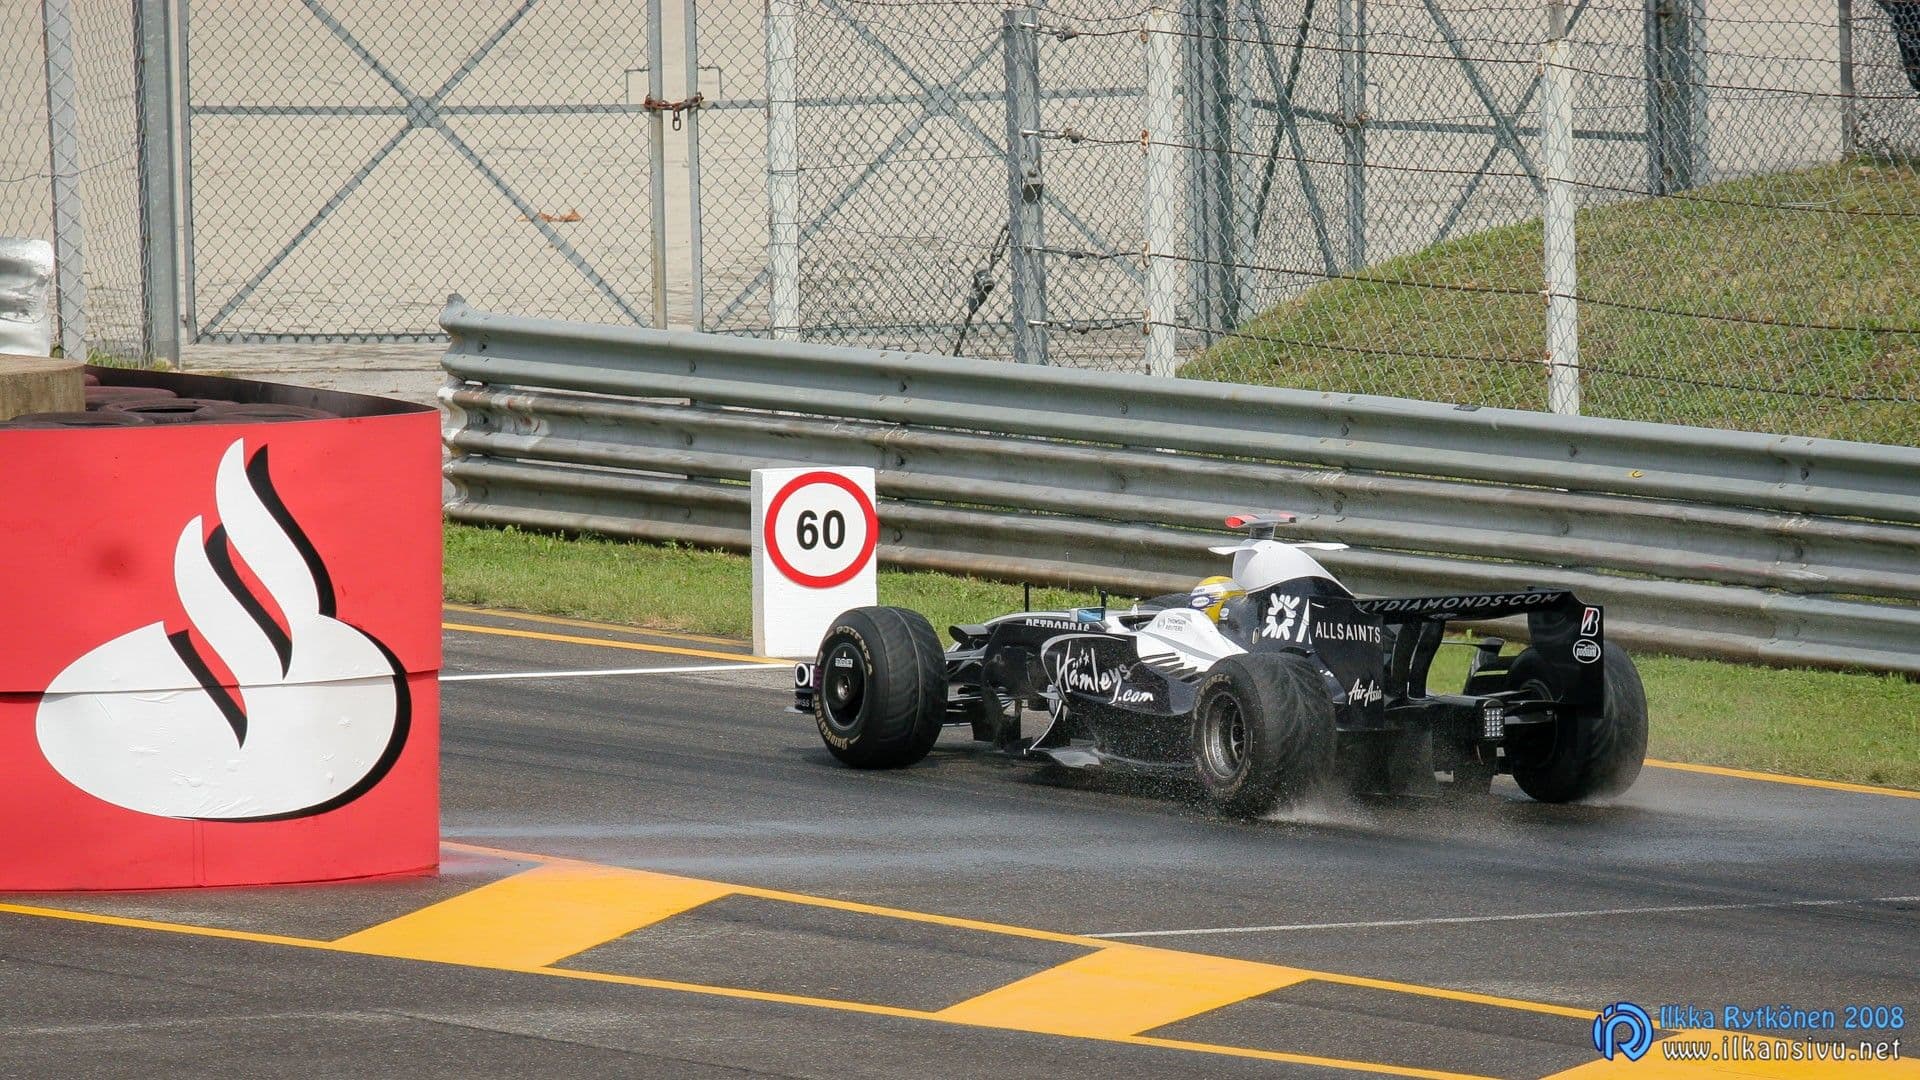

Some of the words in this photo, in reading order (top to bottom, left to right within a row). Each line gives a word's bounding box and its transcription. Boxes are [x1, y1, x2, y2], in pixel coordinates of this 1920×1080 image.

[797, 509, 845, 550] 60
[1315, 621, 1381, 643] ALLSAINTS
[1055, 640, 1131, 705] Hamleys
